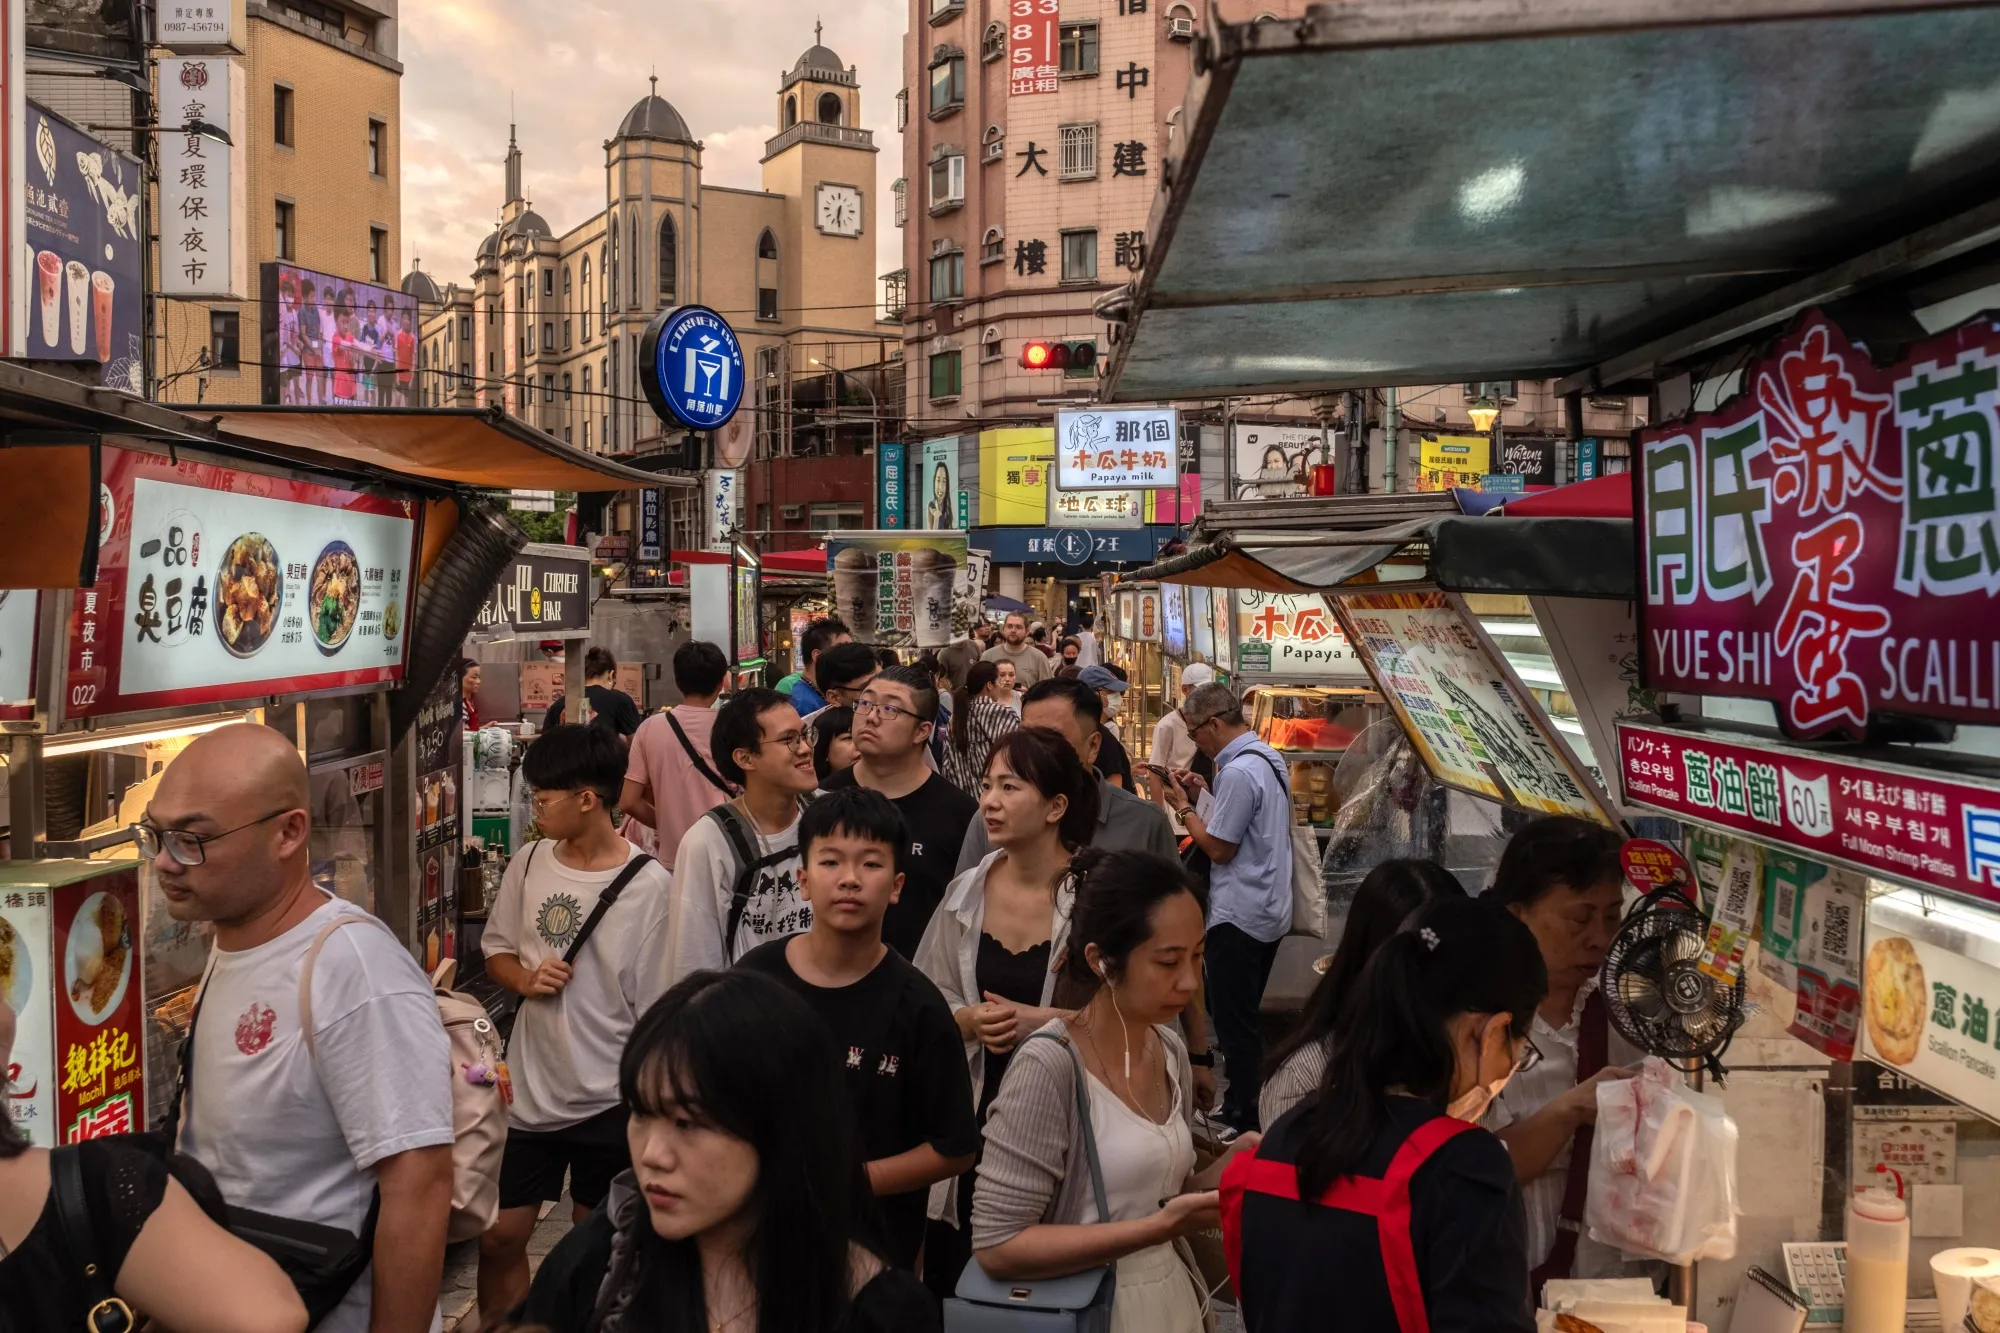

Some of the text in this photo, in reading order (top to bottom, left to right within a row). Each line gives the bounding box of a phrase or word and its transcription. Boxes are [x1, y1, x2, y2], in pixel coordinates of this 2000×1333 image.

[164, 22, 225, 32] 0987-456794
[179, 99, 209, 286] 寧夏環保夜市
[669, 316, 740, 366] CORNER BAR
[686, 398, 723, 416] 角落小吧
[1116, 421, 1169, 443] 那個
[1072, 449, 1167, 471] 木瓜牛奶
[1505, 444, 1543, 461] Watsons
[1091, 472, 1154, 483] Papaya milk
[1518, 460, 1542, 475] Club
[885, 465, 898, 510] 屈臣氏
[1058, 495, 1128, 512] 地瓜球
[644, 489, 658, 543] 數位影像
[140, 526, 188, 567] 一品
[1095, 537, 1120, 552] 之王
[286, 562, 308, 581] 臭豆腐
[543, 572, 578, 594] CORNER
[878, 551, 894, 630] 招牌綠豆沙
[134, 573, 208, 644] 臭豆腐
[543, 600, 561, 622] BAR
[1283, 645, 1342, 663] Papaya
[1652, 628, 1772, 686] YUE SHI
[72, 684, 96, 706] 022
[1628, 777, 1680, 802] Scallion Pancake
[1683, 749, 1782, 827] 蔥油餅
[1845, 807, 1950, 848] 새우부침개
[912, 842, 923, 856] R
[1841, 832, 1957, 878] Full Moon Shrimp Patties
[0, 891, 46, 908] 橋頭
[1930, 981, 2000, 1053] 蔥油
[1928, 1034, 1959, 1066] Scallion
[1958, 1048, 1997, 1081] Pancake
[78, 1083, 102, 1106] Mochi
